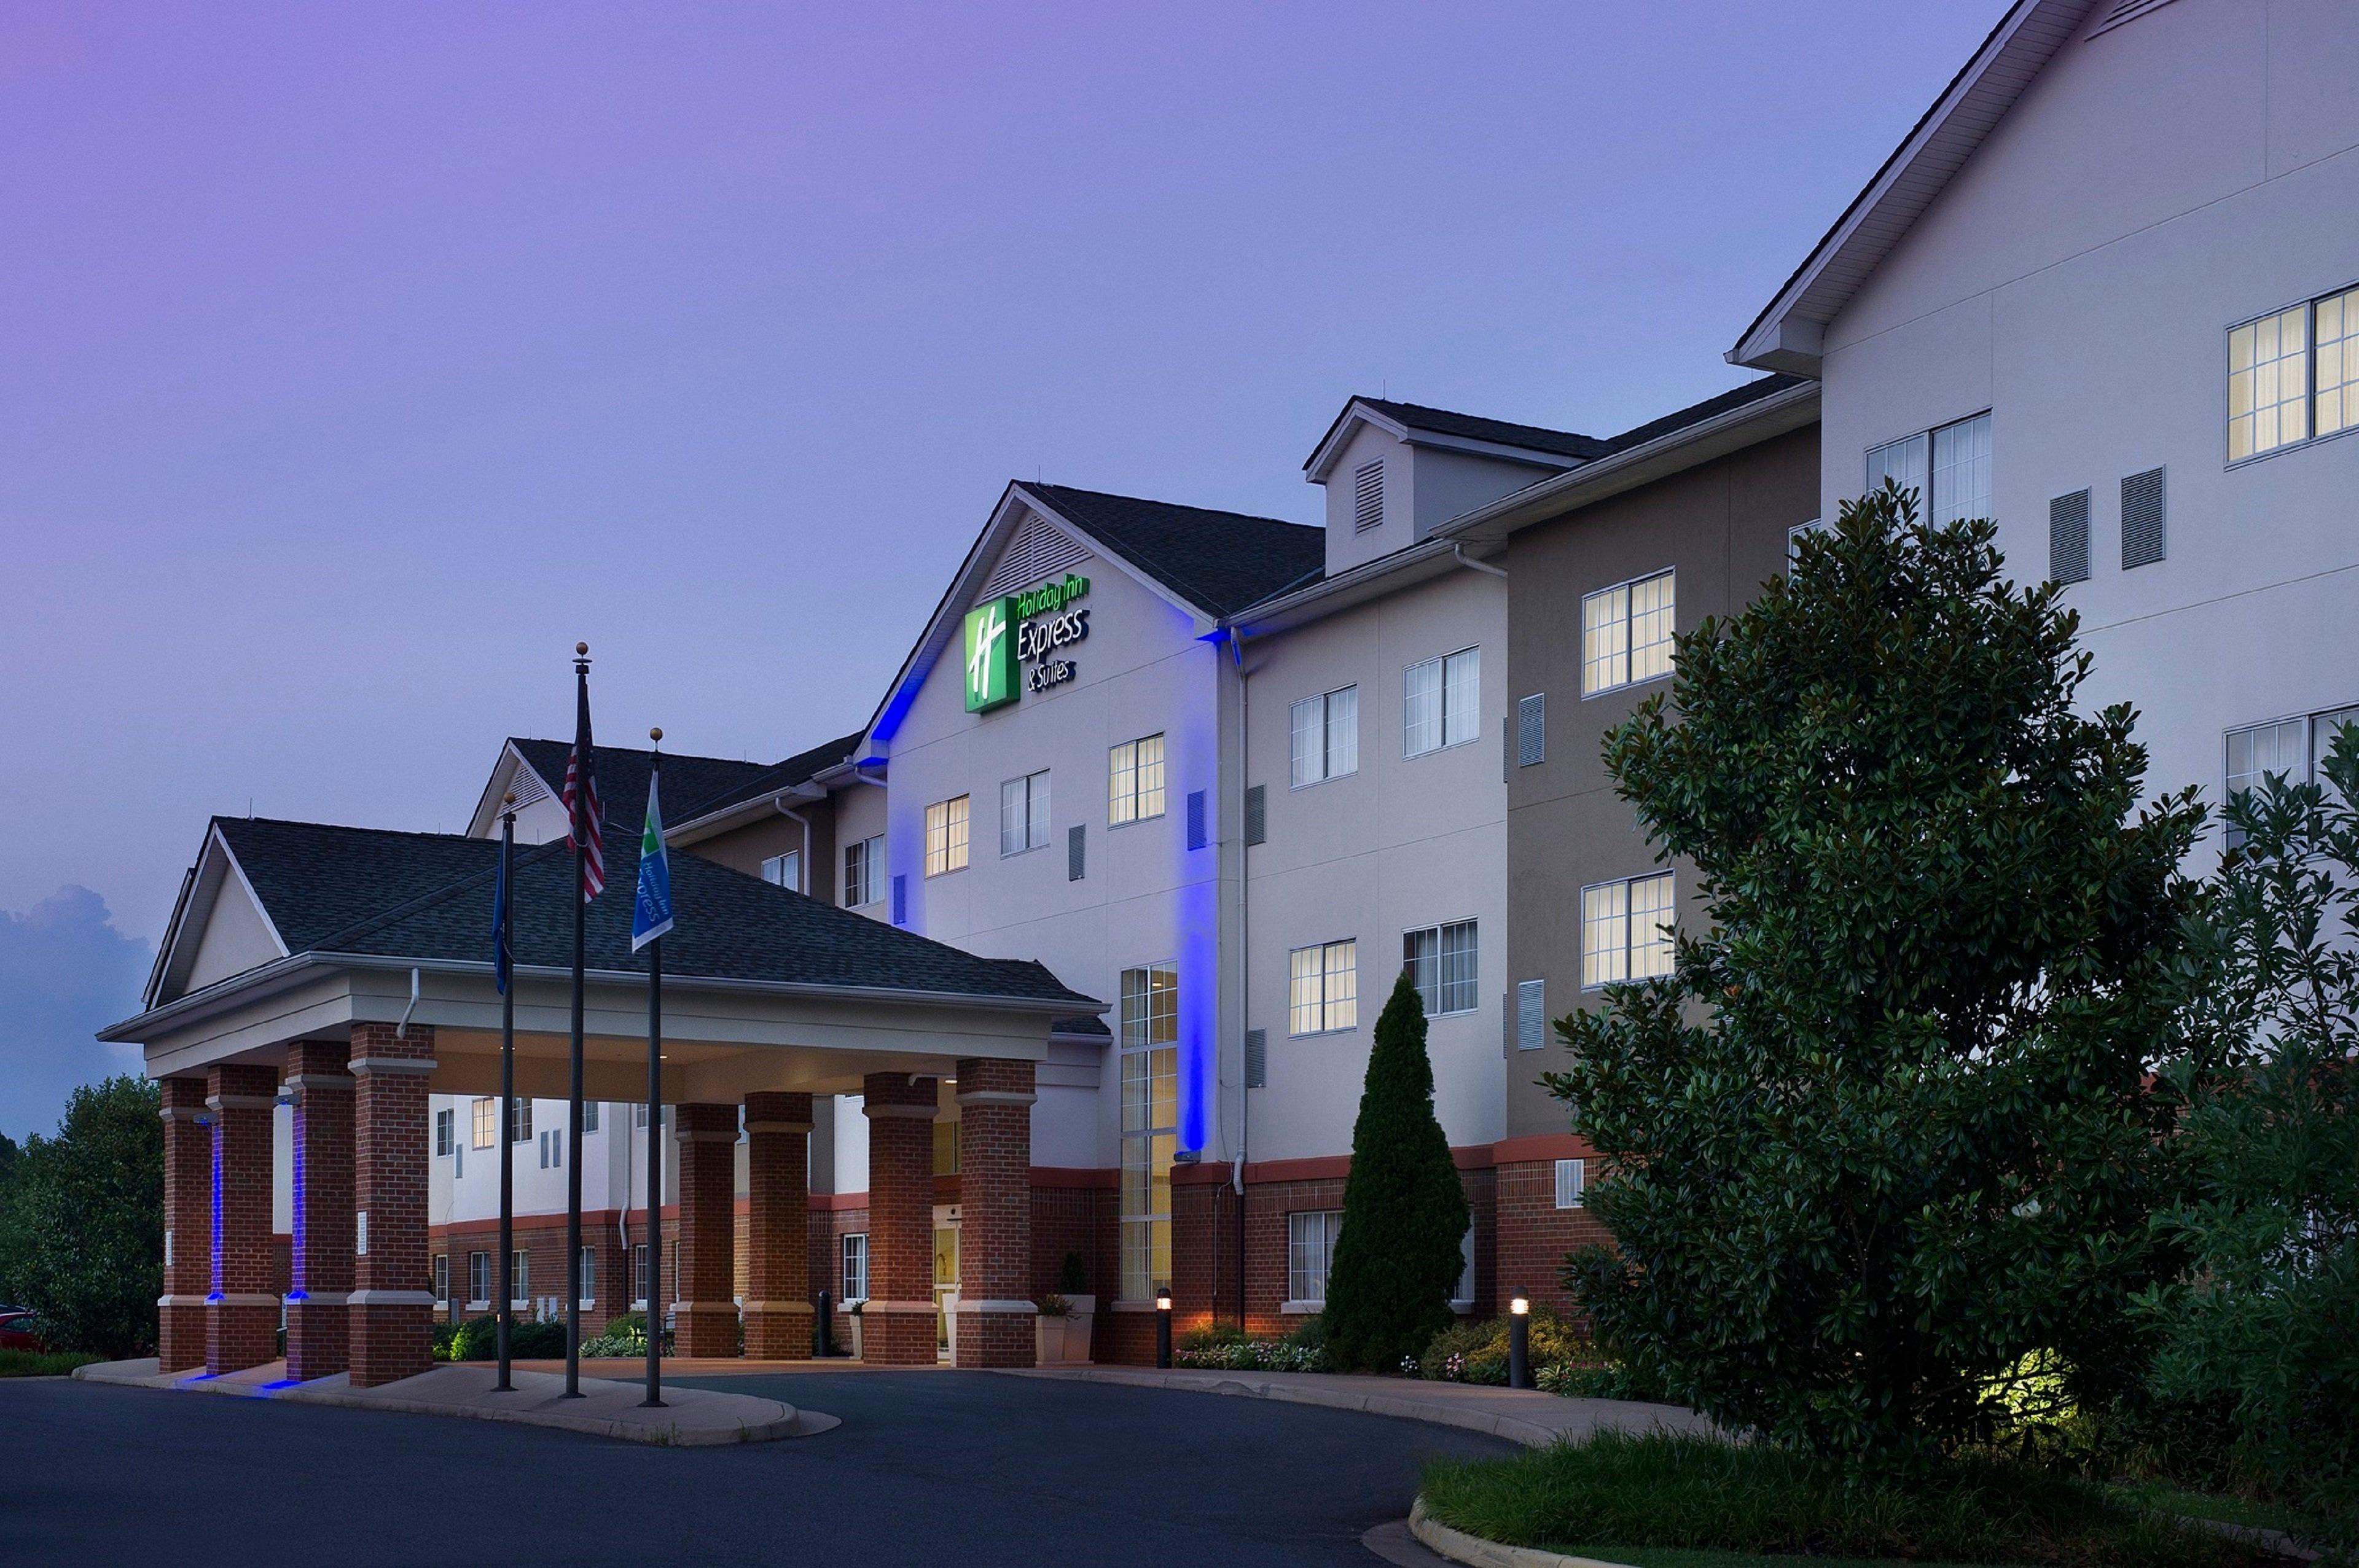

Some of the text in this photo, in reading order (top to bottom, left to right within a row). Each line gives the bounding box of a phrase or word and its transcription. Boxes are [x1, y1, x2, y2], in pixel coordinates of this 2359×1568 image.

[1017, 573, 1083, 620] Holiday Inn
[1017, 609, 1083, 663] Express
[1027, 660, 1070, 692] & Suites
